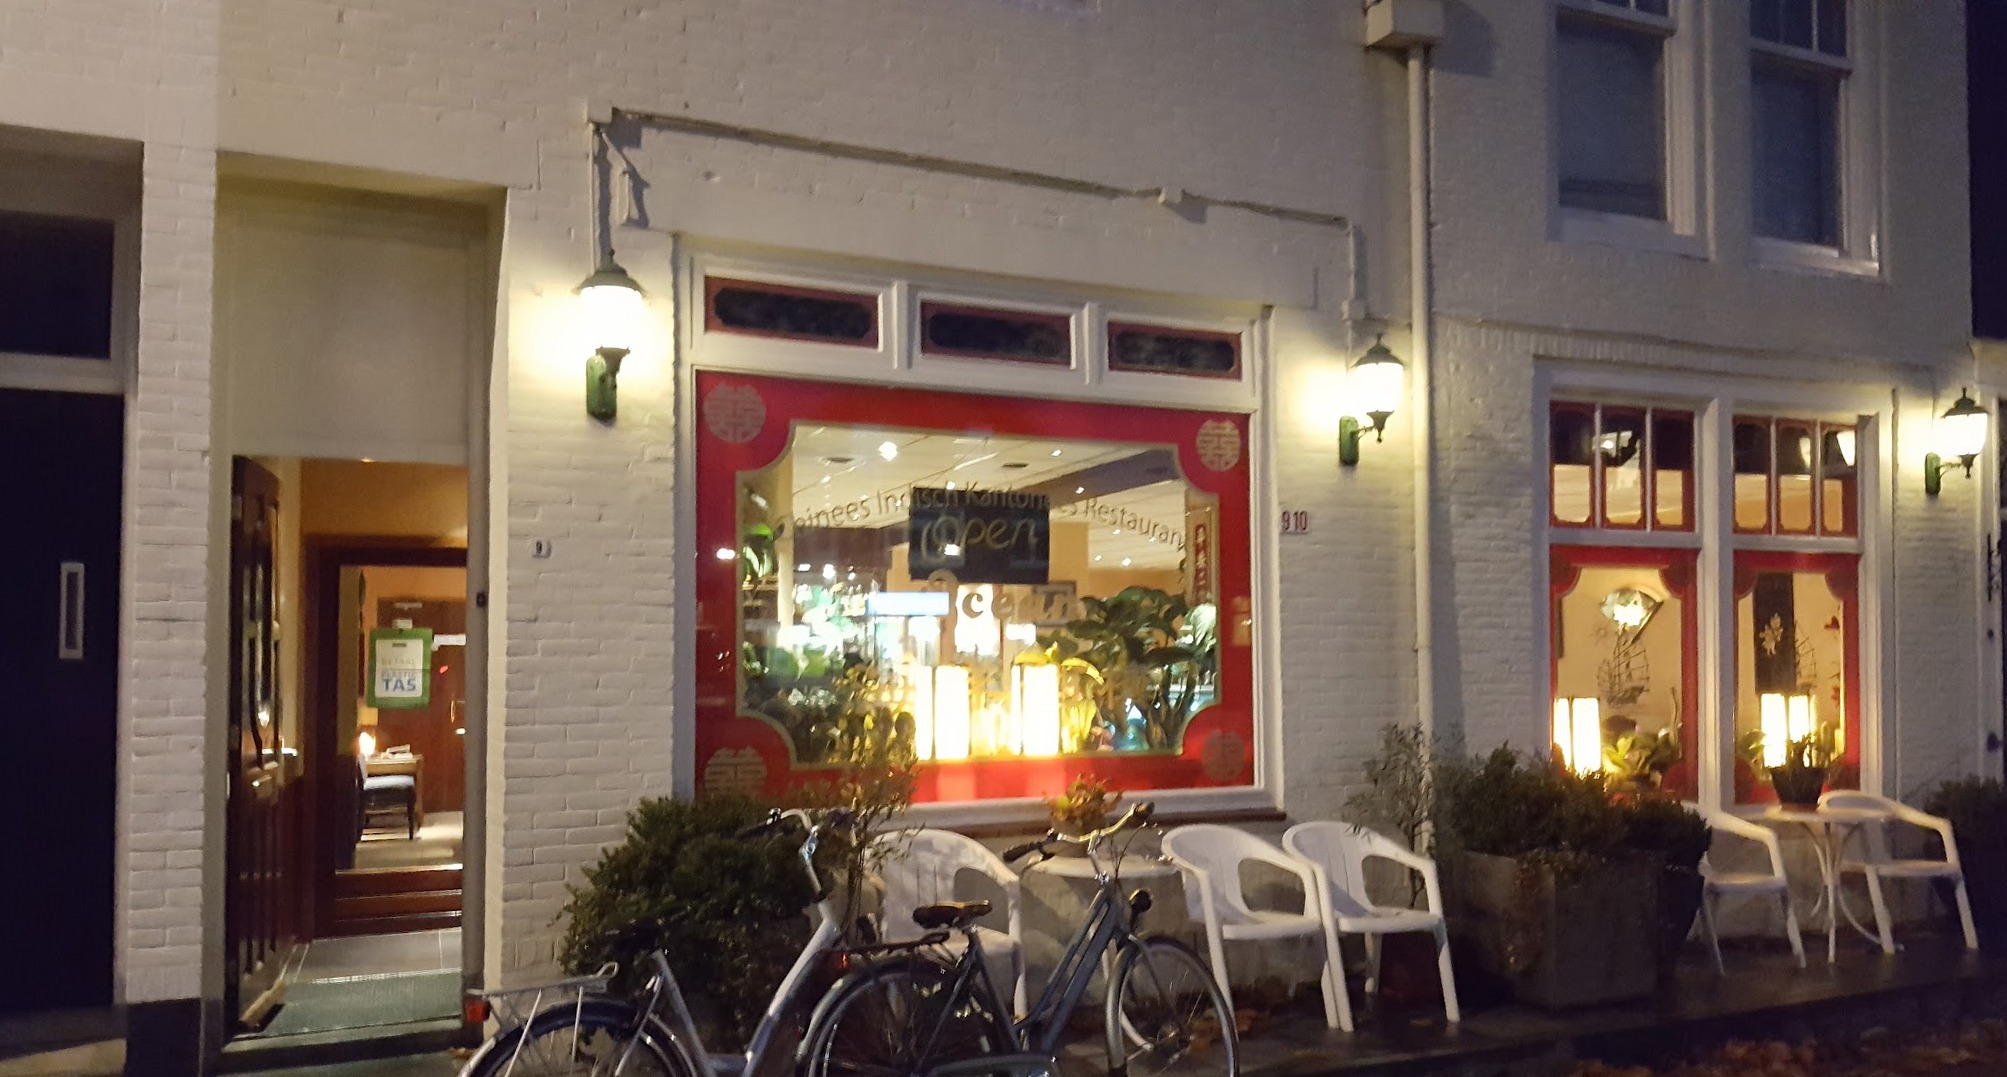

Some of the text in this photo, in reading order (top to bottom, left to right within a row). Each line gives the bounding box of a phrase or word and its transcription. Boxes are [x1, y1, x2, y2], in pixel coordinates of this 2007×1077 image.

[965, 480, 1078, 516] Kantones
[921, 512, 1037, 561] Open
[383, 679, 417, 692] TAS
